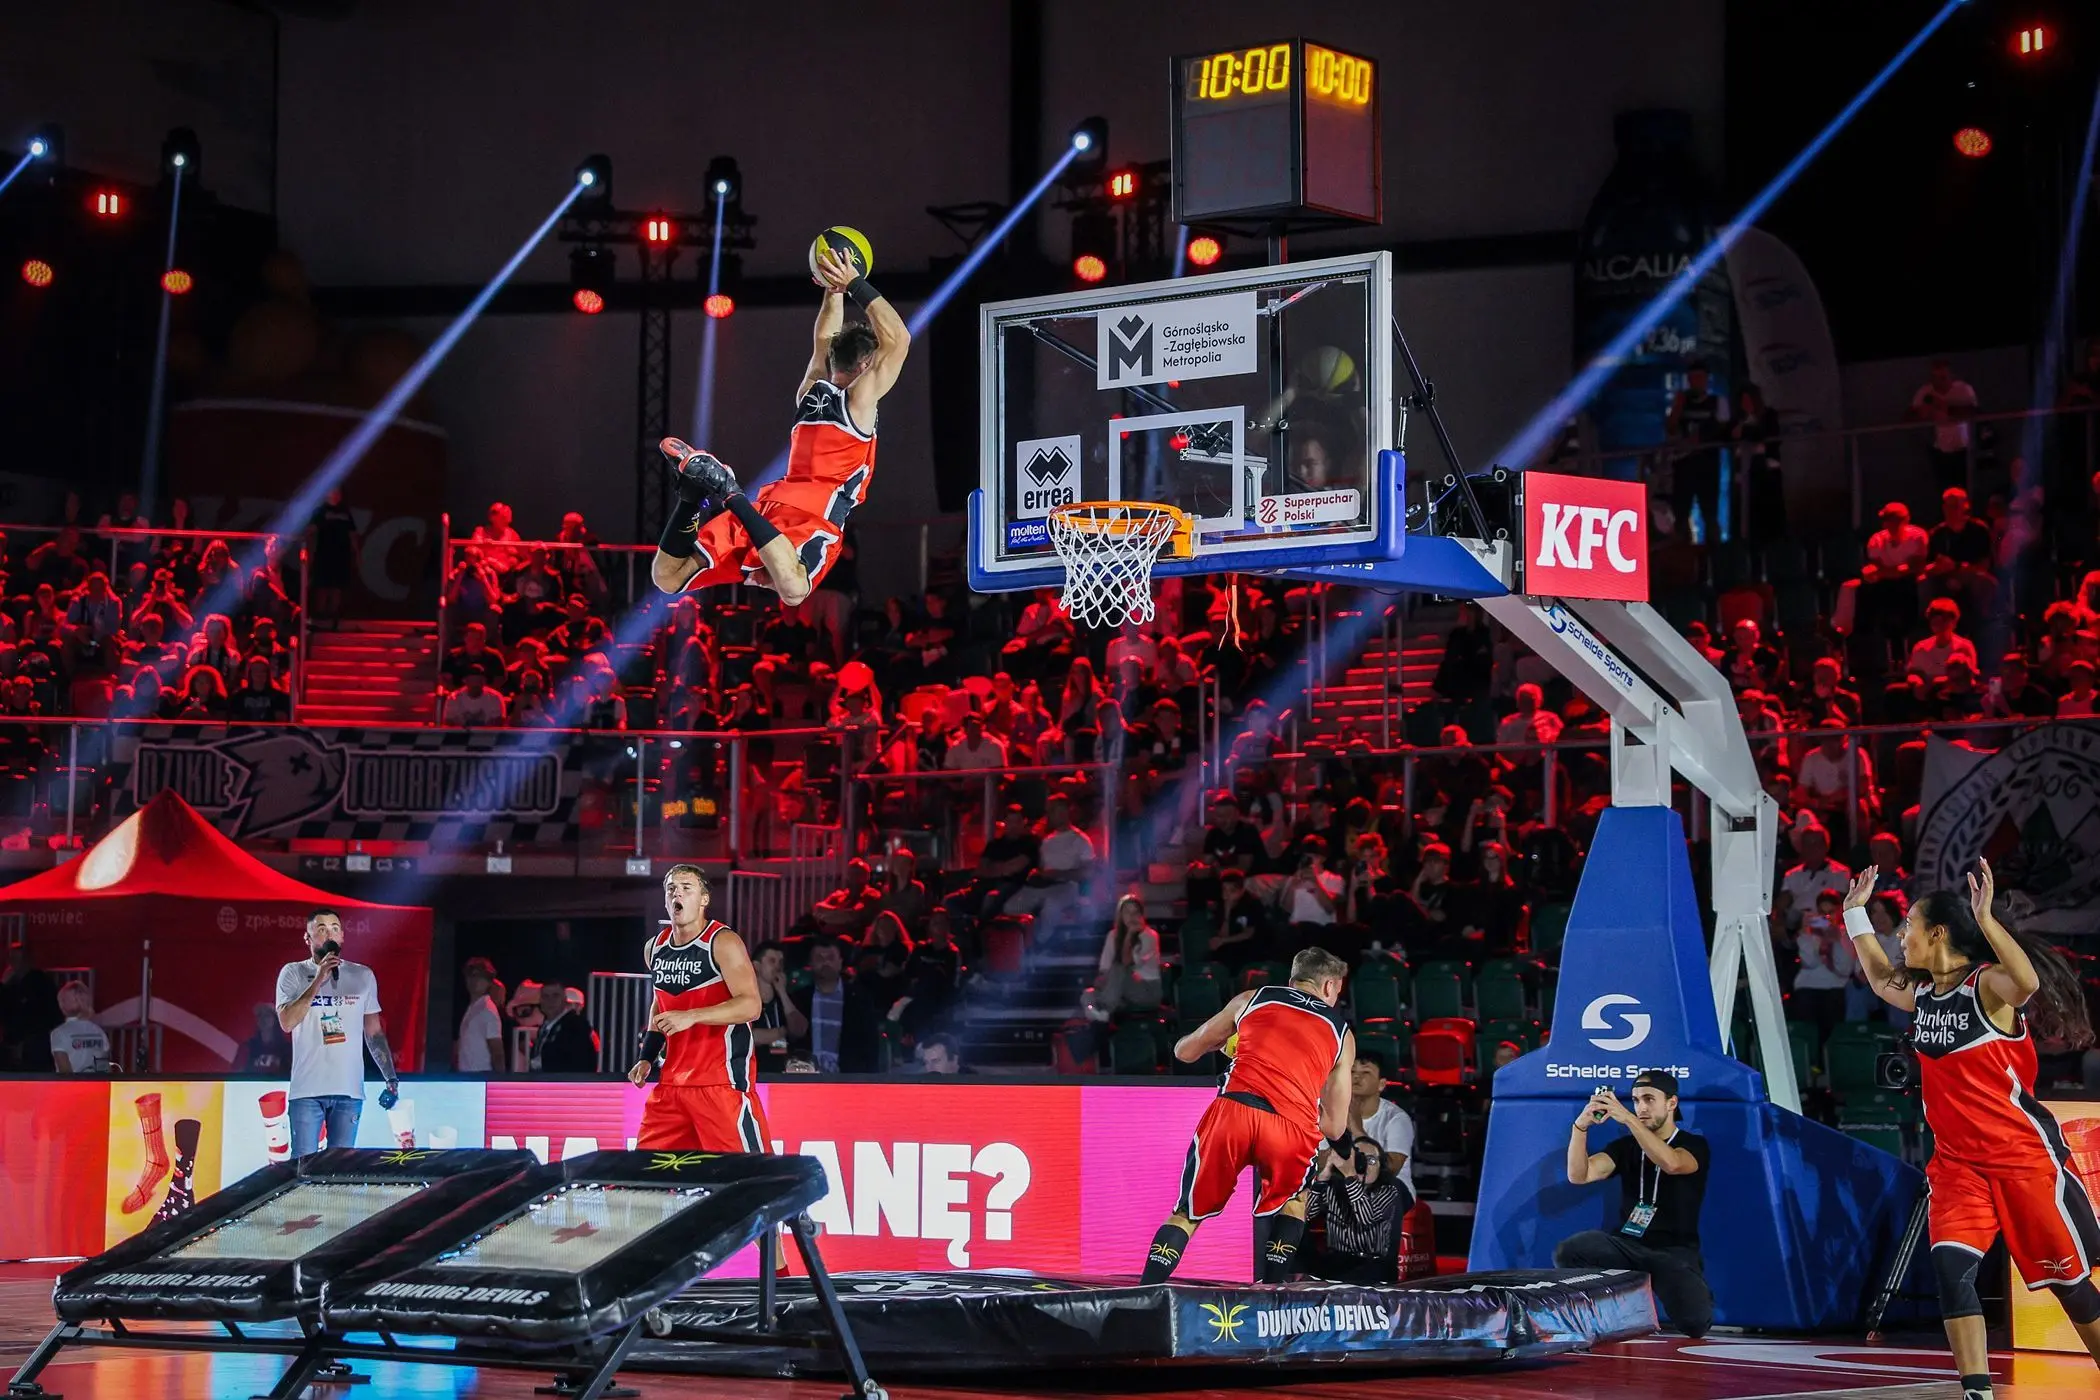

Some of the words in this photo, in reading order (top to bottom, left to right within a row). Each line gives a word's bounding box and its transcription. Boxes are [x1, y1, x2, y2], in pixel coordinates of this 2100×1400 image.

[1199, 43, 1291, 99] 10:00
[1311, 49, 1372, 105] 10:00
[1162, 320, 1230, 339] Górnośląsko
[1163, 333, 1246, 354] -Zagłębiowska
[1163, 351, 1222, 368] Metropolia
[1284, 493, 1354, 508] Superpuchar
[1284, 508, 1315, 522] Polski
[1010, 524, 1046, 538] molten
[1536, 502, 1639, 574] KFC
[1567, 621, 1604, 661] Schelde
[1604, 654, 1634, 687] Sports
[349, 755, 555, 811] TOWARZYSTWO
[652, 957, 703, 975] Dunking
[654, 970, 691, 986] Devils
[1546, 1063, 1622, 1079] Schelde
[94, 1272, 193, 1287] DUNKING
[186, 1274, 267, 1288] DEVILS
[364, 1281, 470, 1300] DUNKING
[463, 1286, 551, 1306] DEVILS
[1257, 1304, 1331, 1338] DUNKING
[1333, 1304, 1390, 1331] DEVILS
